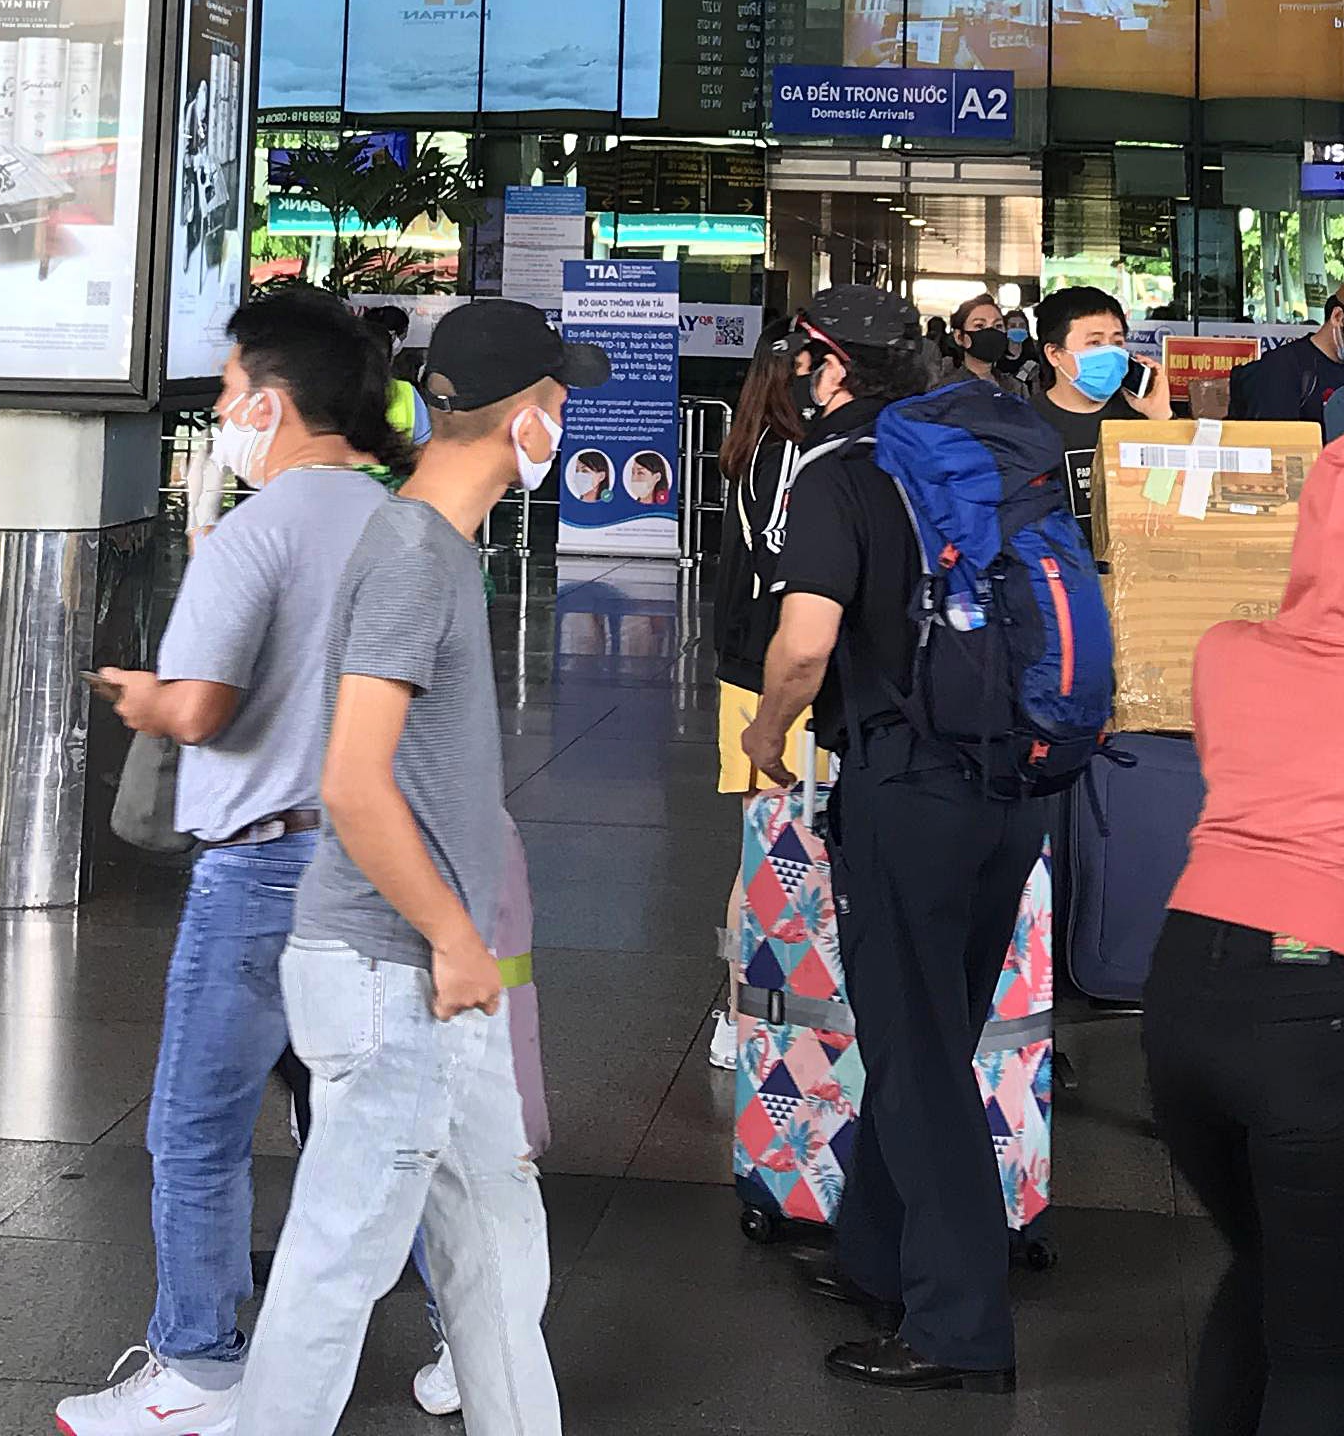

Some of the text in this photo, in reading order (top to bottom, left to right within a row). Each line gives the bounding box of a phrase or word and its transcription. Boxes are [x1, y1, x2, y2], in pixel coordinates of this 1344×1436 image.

[780, 81, 1008, 120] GA ĐẾN TRONG NƯỚC A2
[811, 107, 915, 121] Domestic Arrivals
[585, 265, 619, 279] TIA
[590, 299, 608, 307] GIAO
